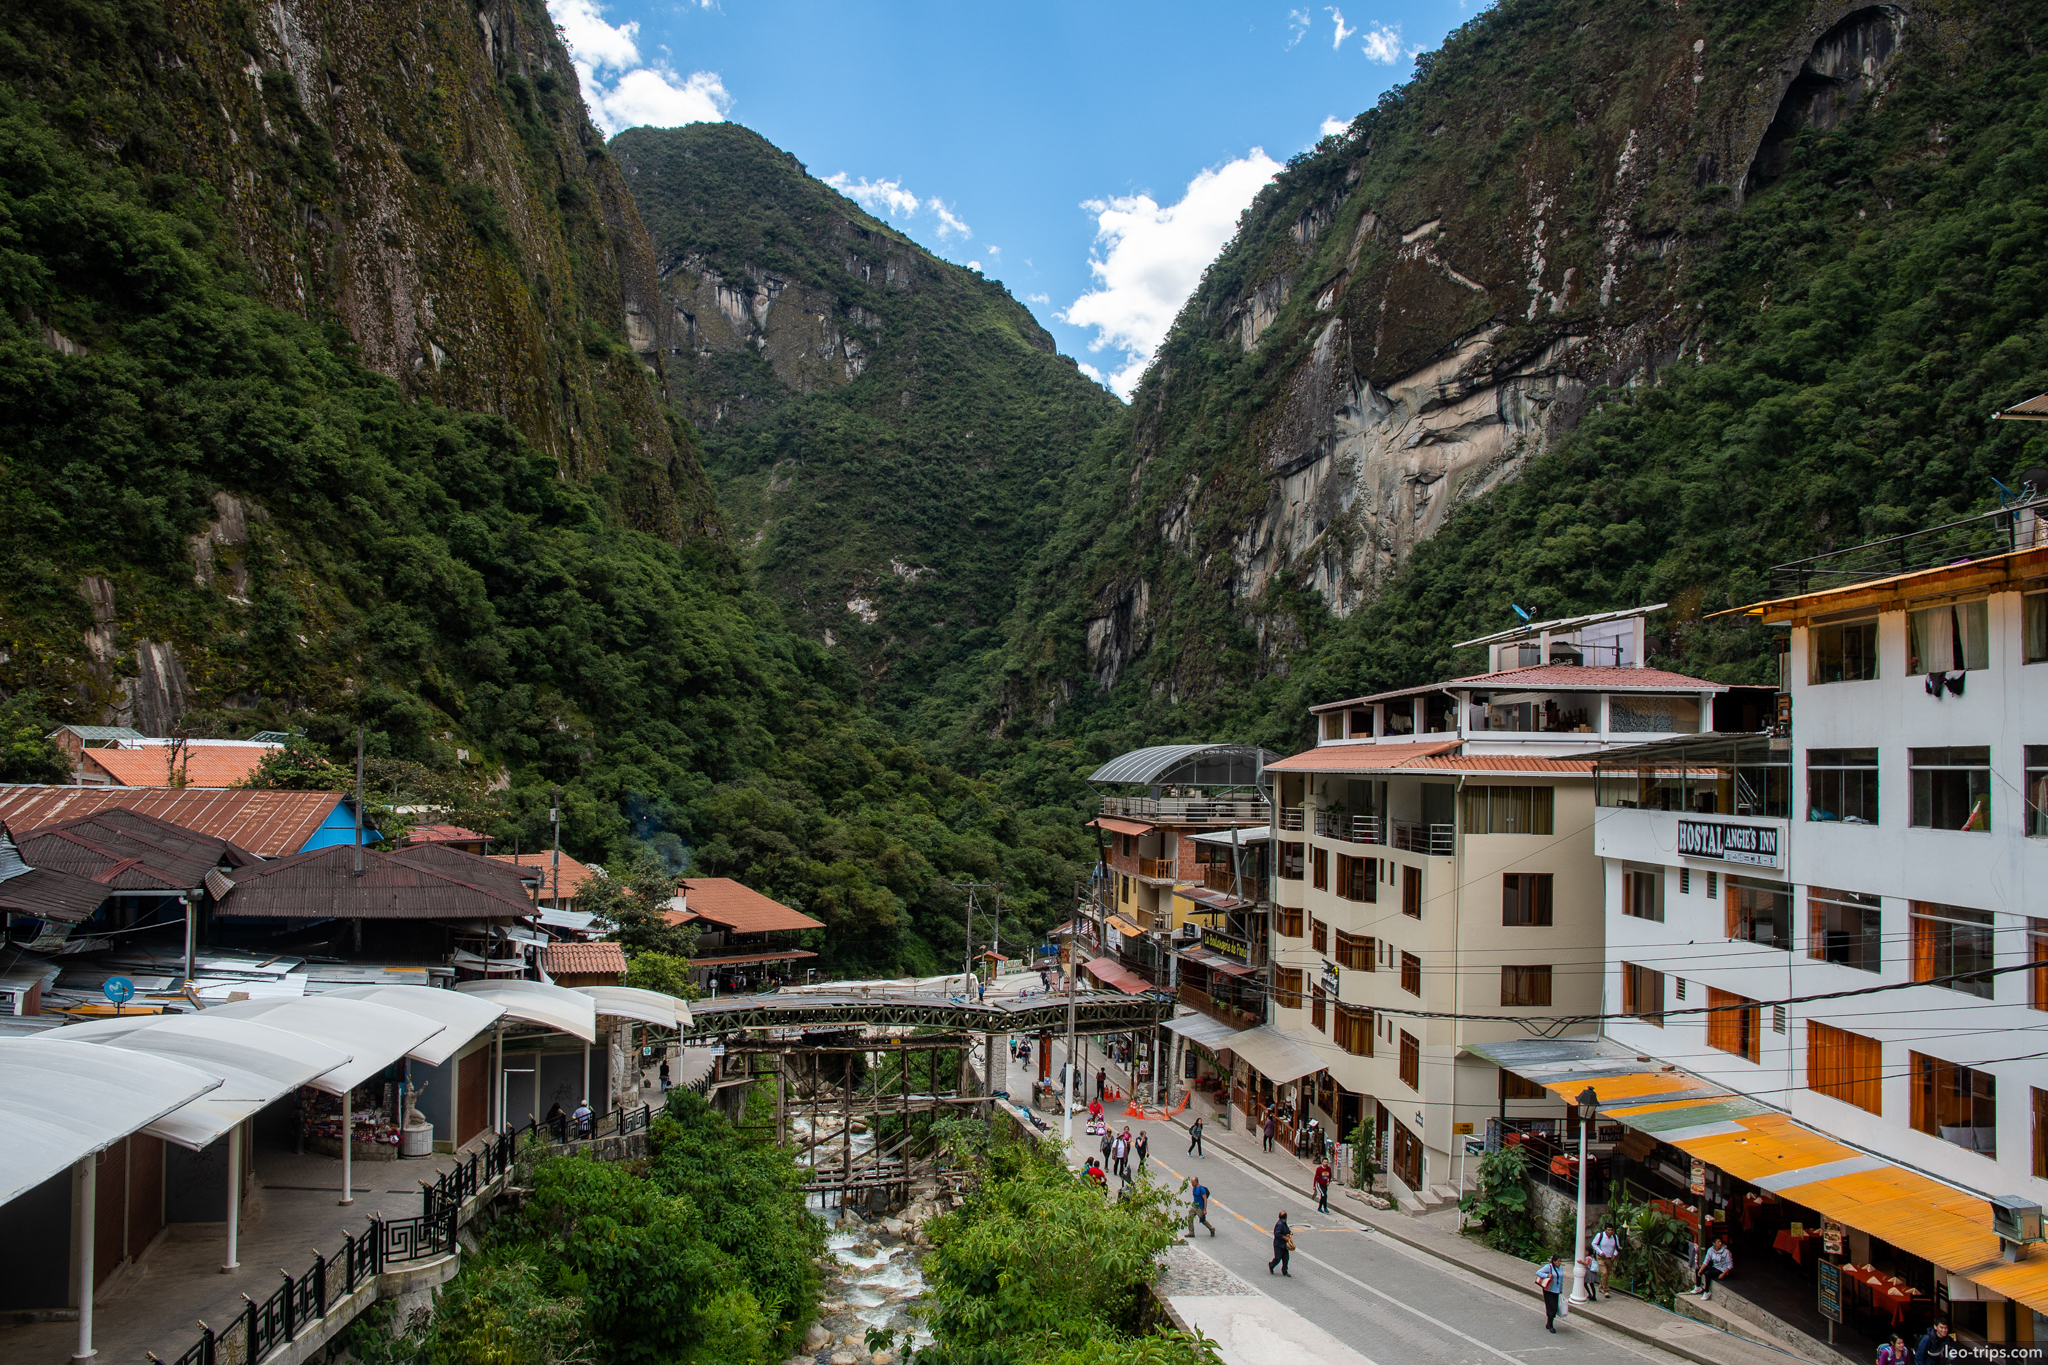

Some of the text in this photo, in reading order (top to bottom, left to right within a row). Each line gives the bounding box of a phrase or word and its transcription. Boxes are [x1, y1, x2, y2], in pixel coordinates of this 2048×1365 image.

[1679, 823, 1776, 855] HOSTAL ANGIE'S INN
